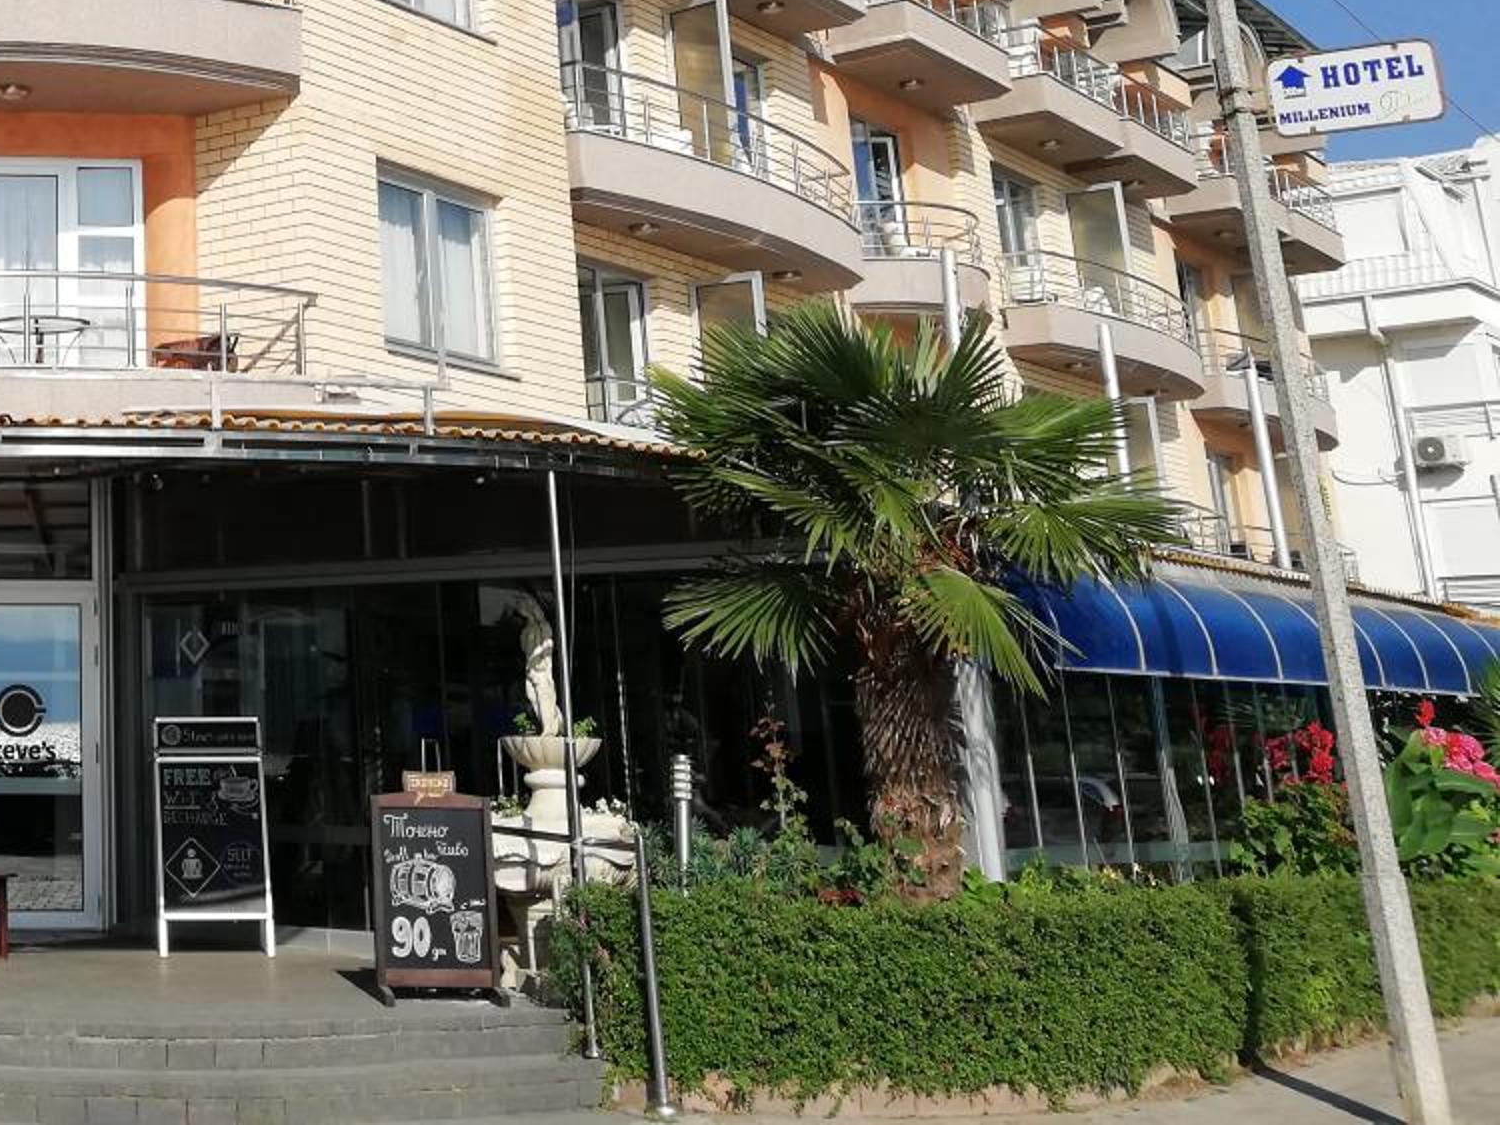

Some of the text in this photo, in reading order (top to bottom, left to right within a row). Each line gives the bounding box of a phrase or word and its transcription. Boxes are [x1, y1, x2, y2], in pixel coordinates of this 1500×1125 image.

[1320, 54, 1425, 90] HOTEL
[1279, 103, 1371, 125] MILLENIUM
[163, 767, 212, 786] FREE
[391, 916, 431, 959] 90
